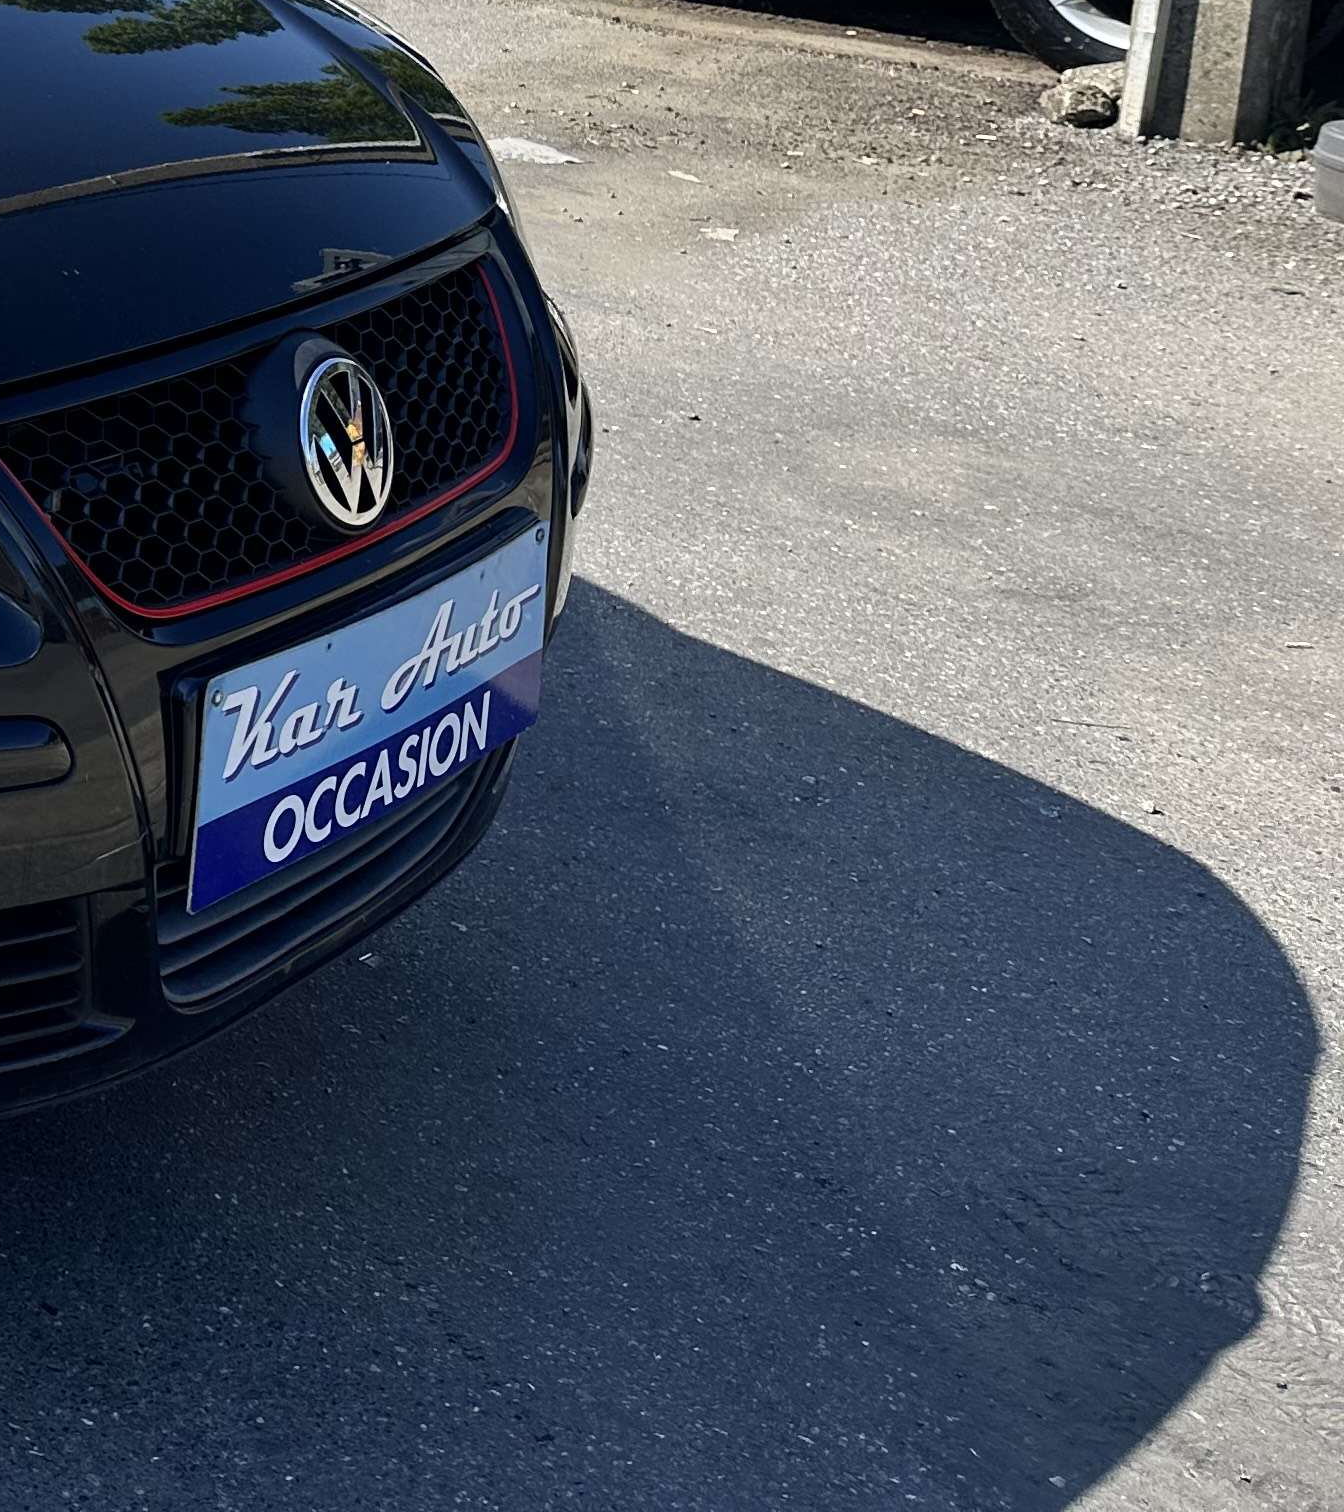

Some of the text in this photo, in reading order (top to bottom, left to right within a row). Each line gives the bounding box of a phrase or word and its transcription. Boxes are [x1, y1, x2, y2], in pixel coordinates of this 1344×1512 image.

[221, 583, 540, 782] Kar Auto
[263, 691, 492, 863] OCCASION
